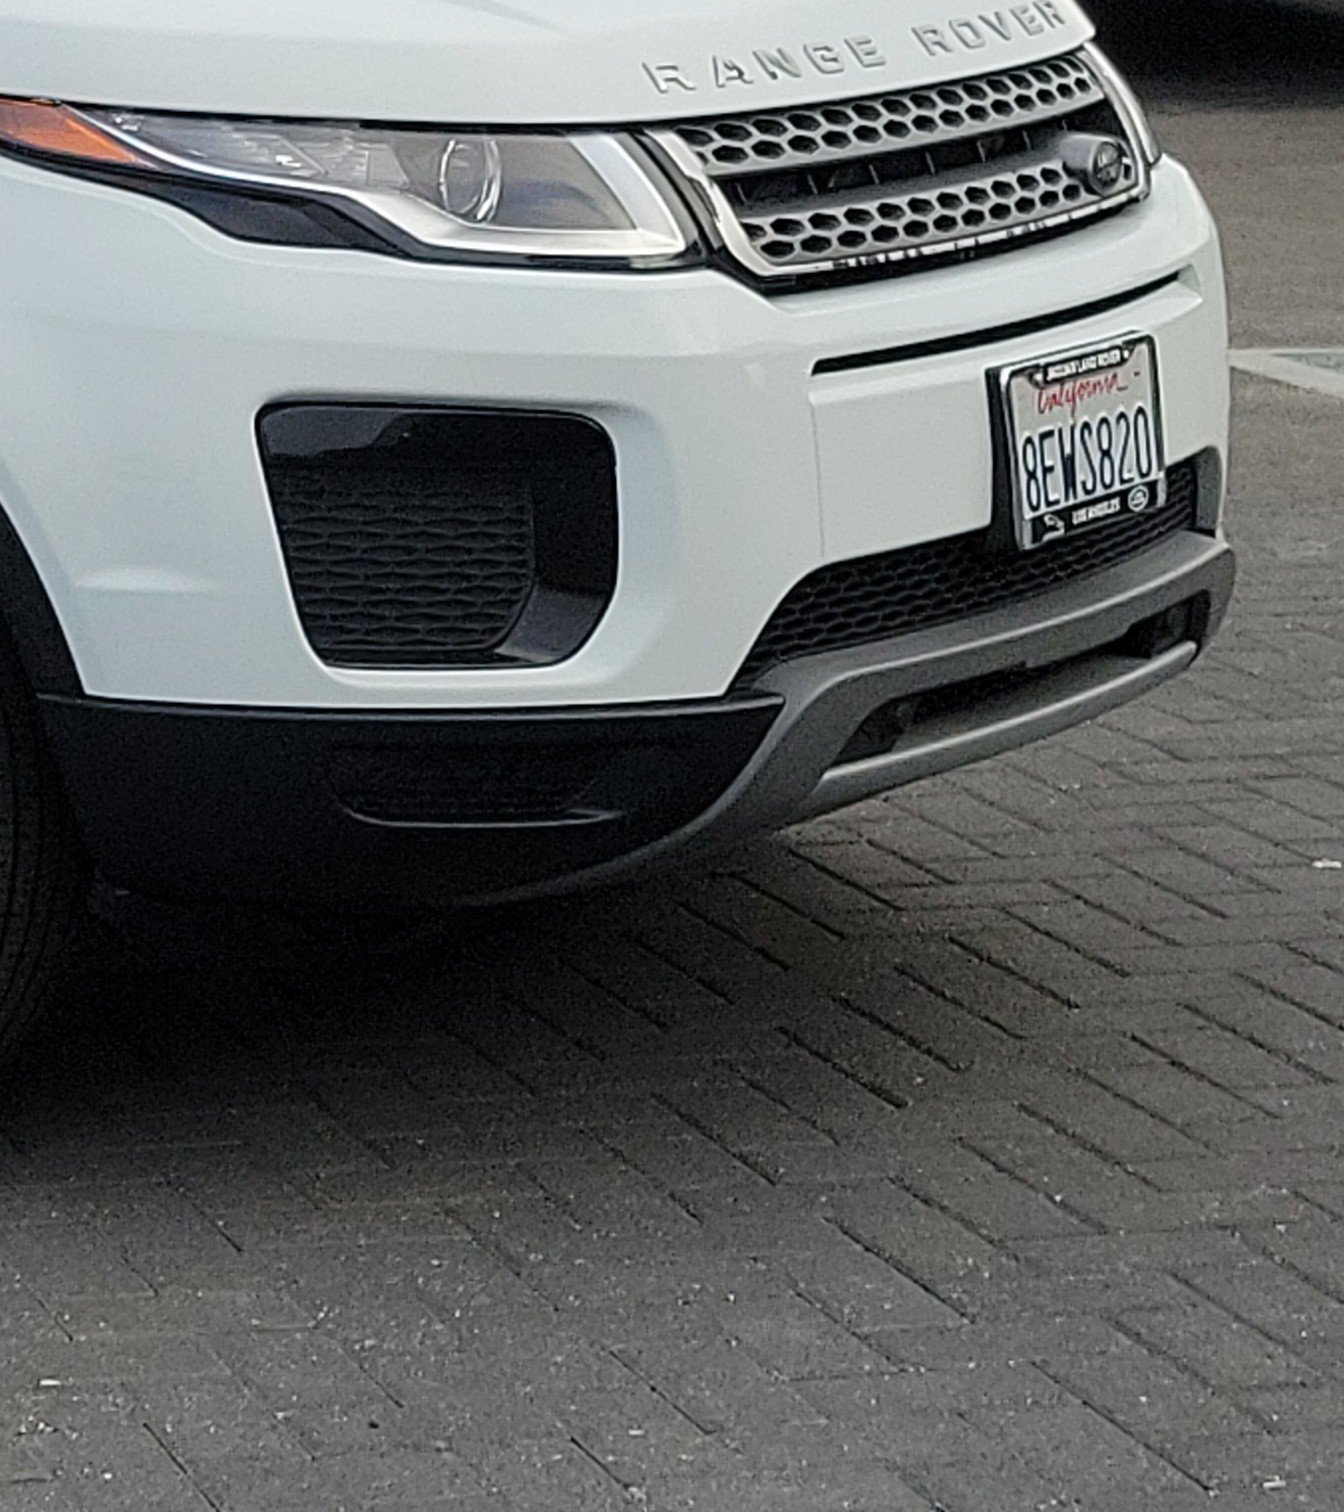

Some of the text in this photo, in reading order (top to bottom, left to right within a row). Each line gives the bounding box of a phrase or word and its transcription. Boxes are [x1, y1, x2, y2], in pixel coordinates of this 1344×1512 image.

[642, 35, 887, 94] RANGE
[1037, 372, 1129, 419] California
[1021, 404, 1153, 513] 8EWS820
